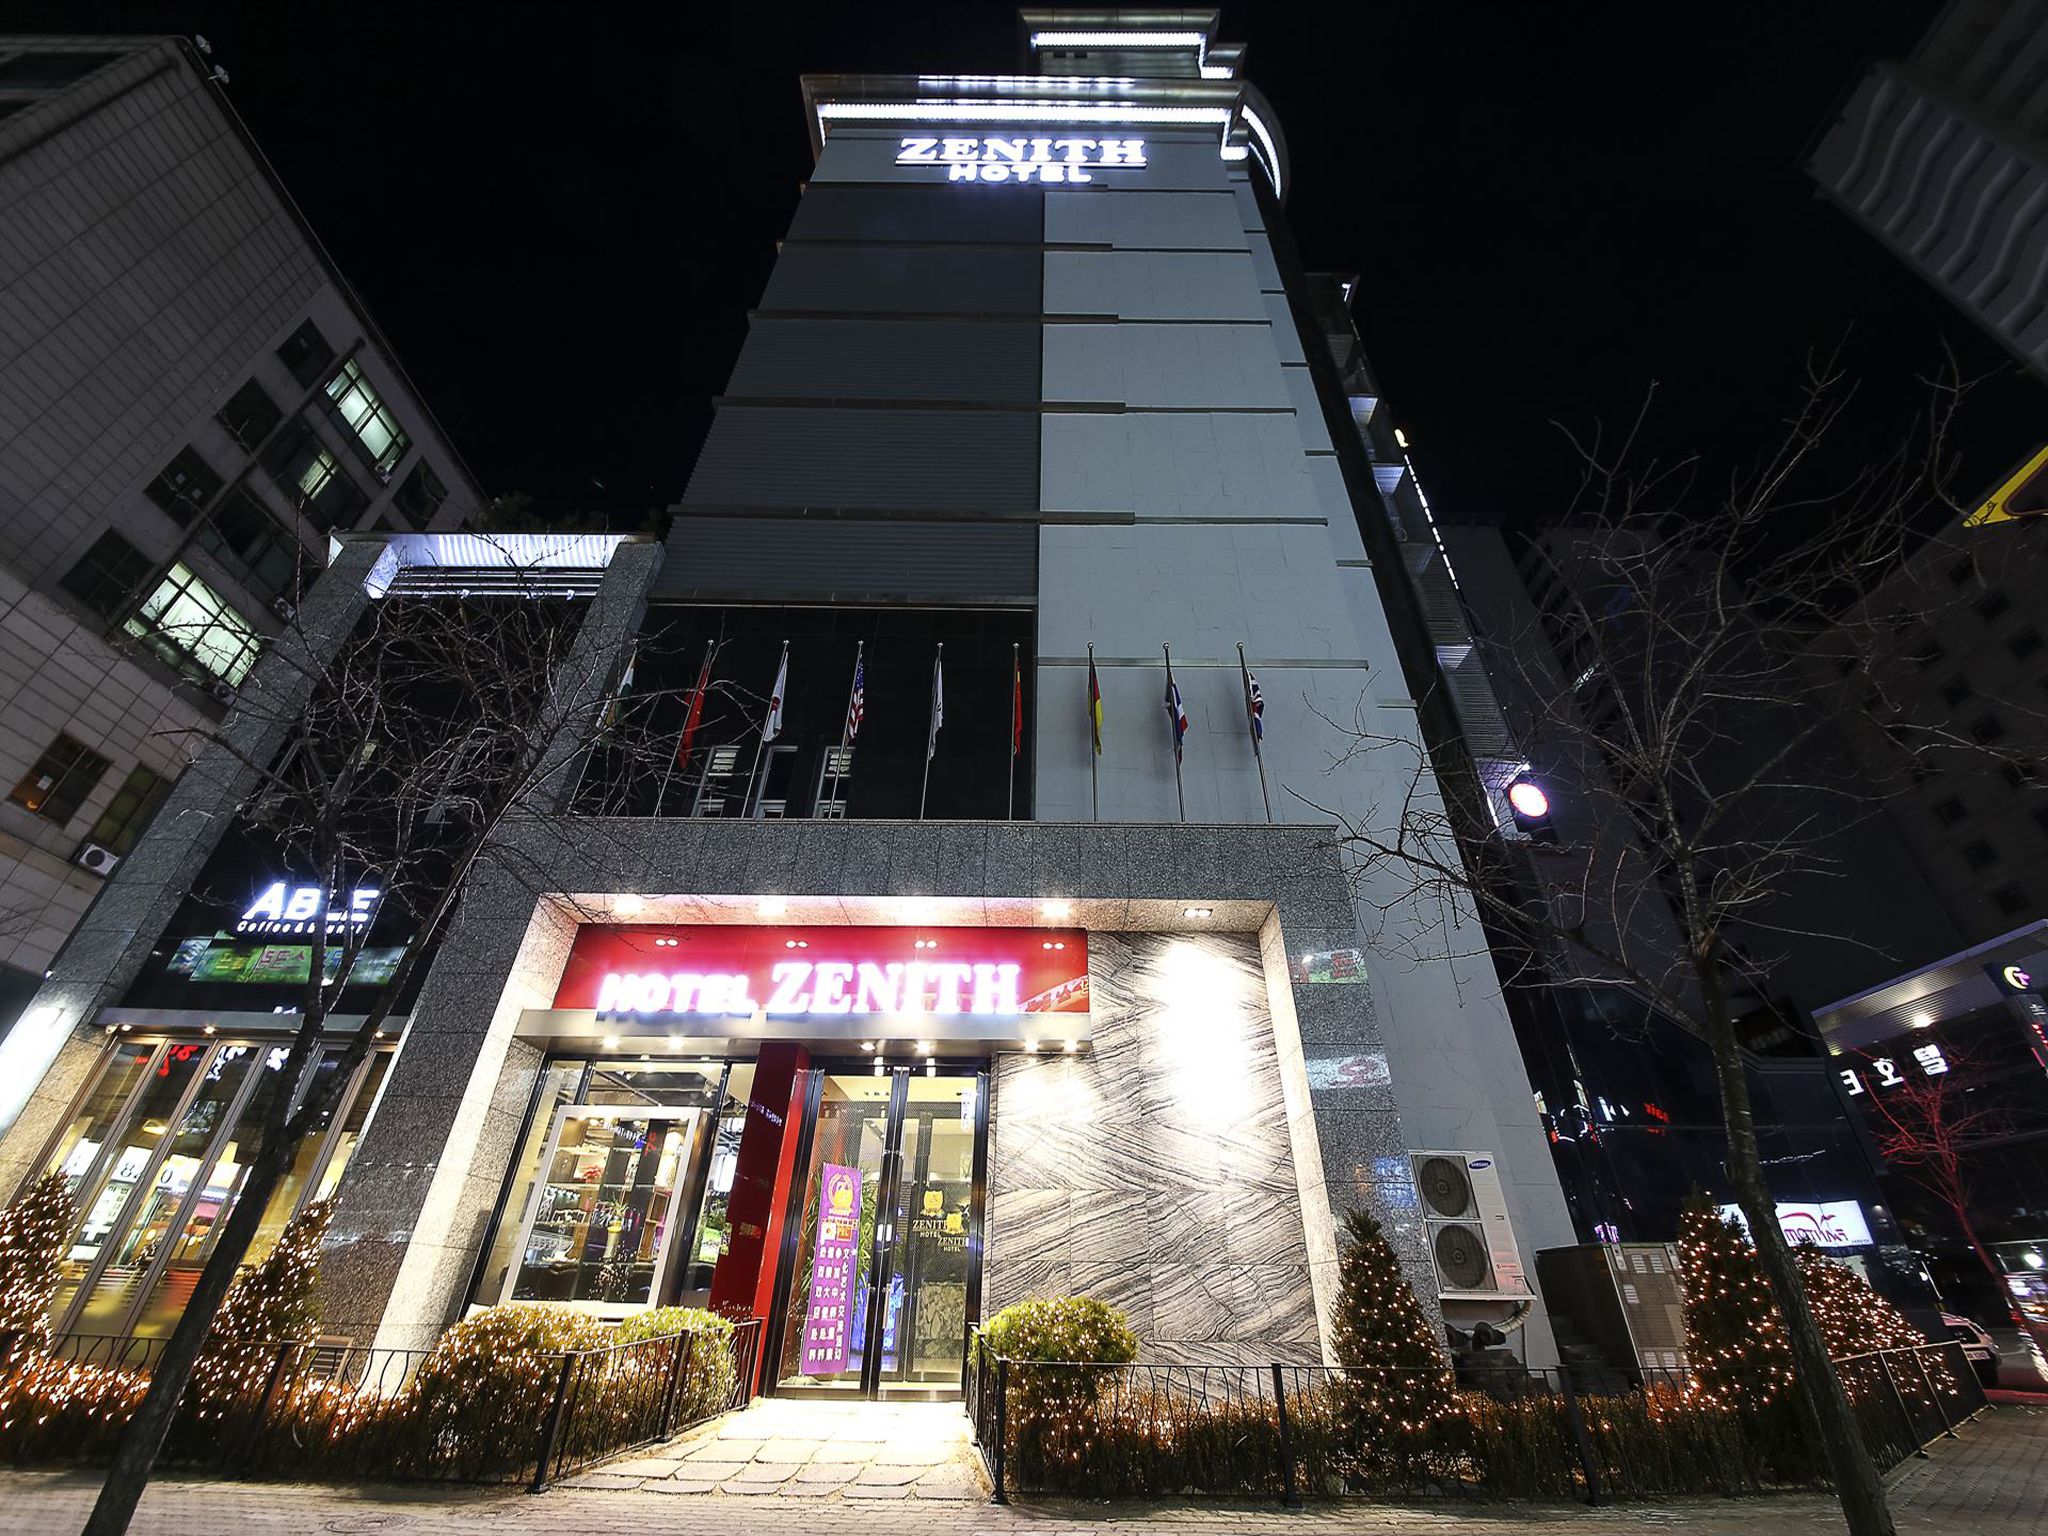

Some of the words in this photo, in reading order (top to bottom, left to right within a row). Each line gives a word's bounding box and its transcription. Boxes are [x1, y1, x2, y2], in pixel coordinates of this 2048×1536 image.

[897, 137, 1148, 163] ZENITH
[949, 164, 1092, 183] HOTEL
[598, 973, 759, 1014] HOTEL
[770, 961, 1021, 1016] ZENITH
